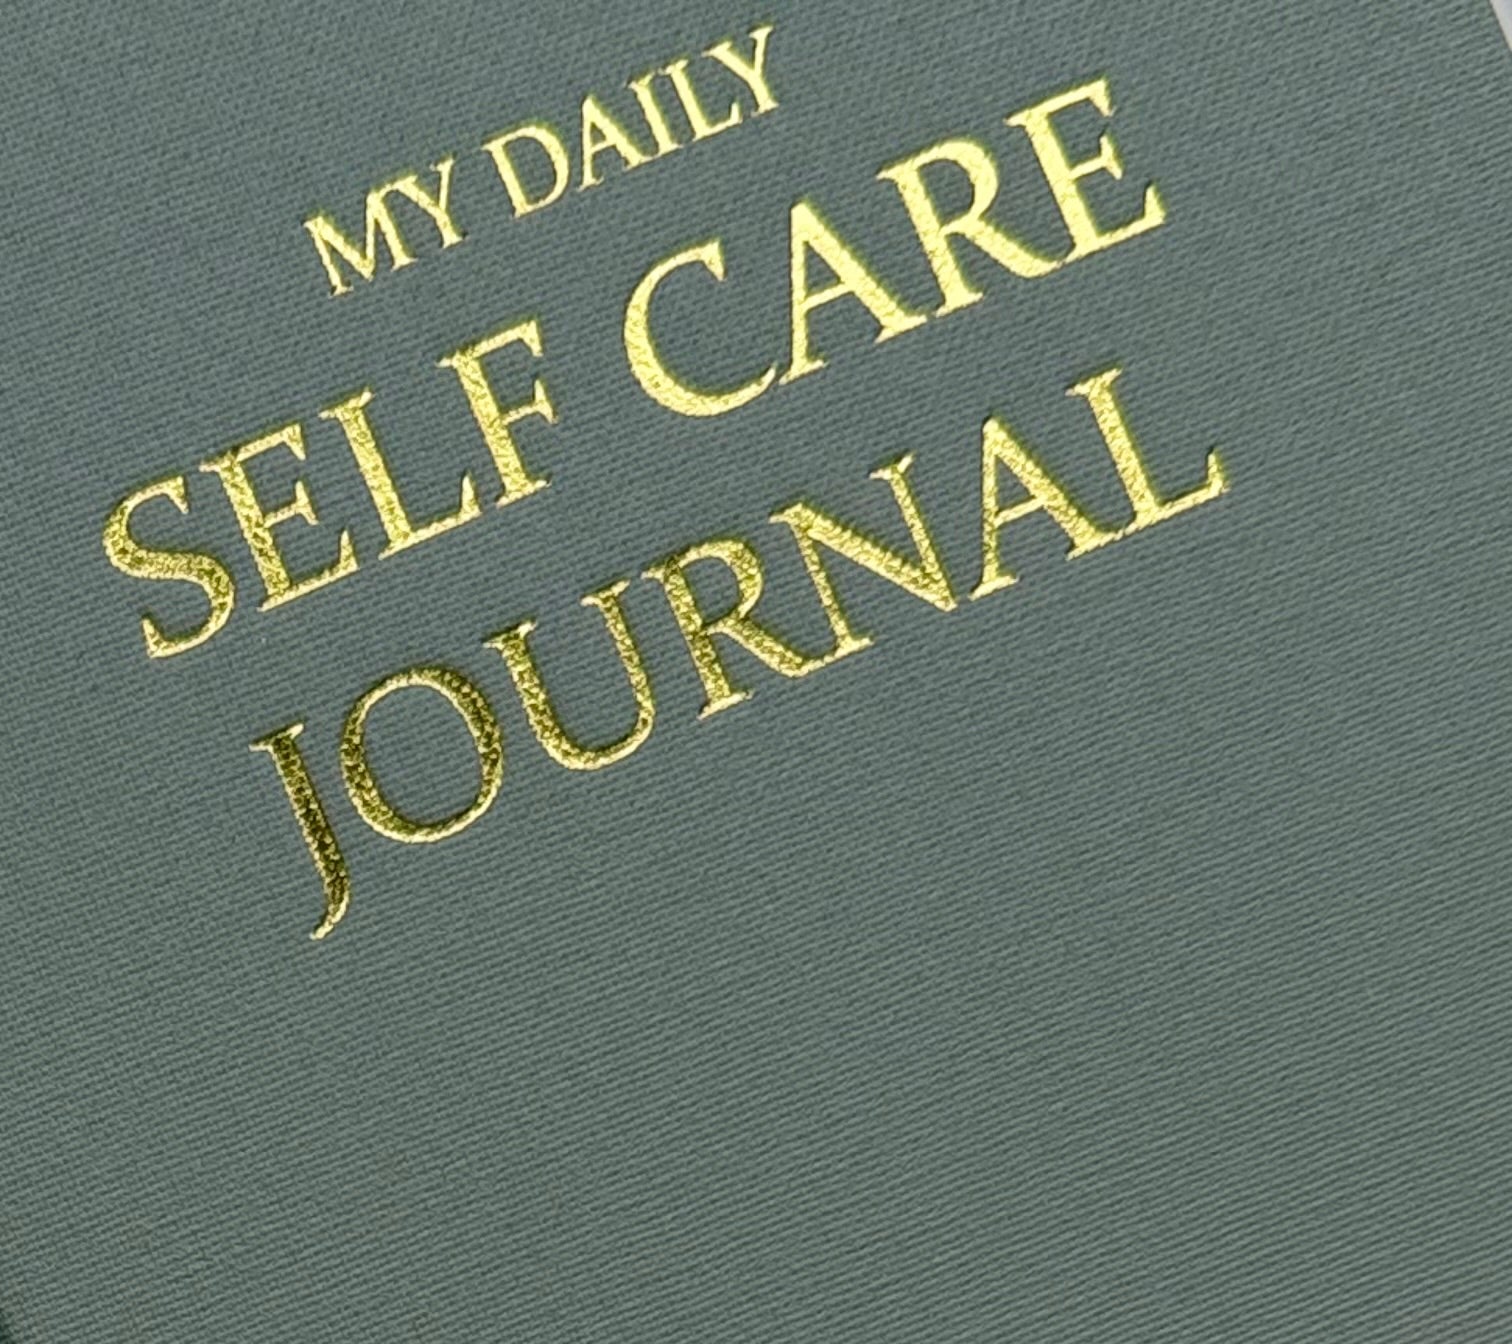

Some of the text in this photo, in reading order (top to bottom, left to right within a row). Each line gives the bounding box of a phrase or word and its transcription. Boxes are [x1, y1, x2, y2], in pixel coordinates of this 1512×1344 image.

[100, 79, 1168, 660] SELF CARE
[303, 25, 780, 298] MY DAILY
[249, 367, 1231, 940] JOURNAL
